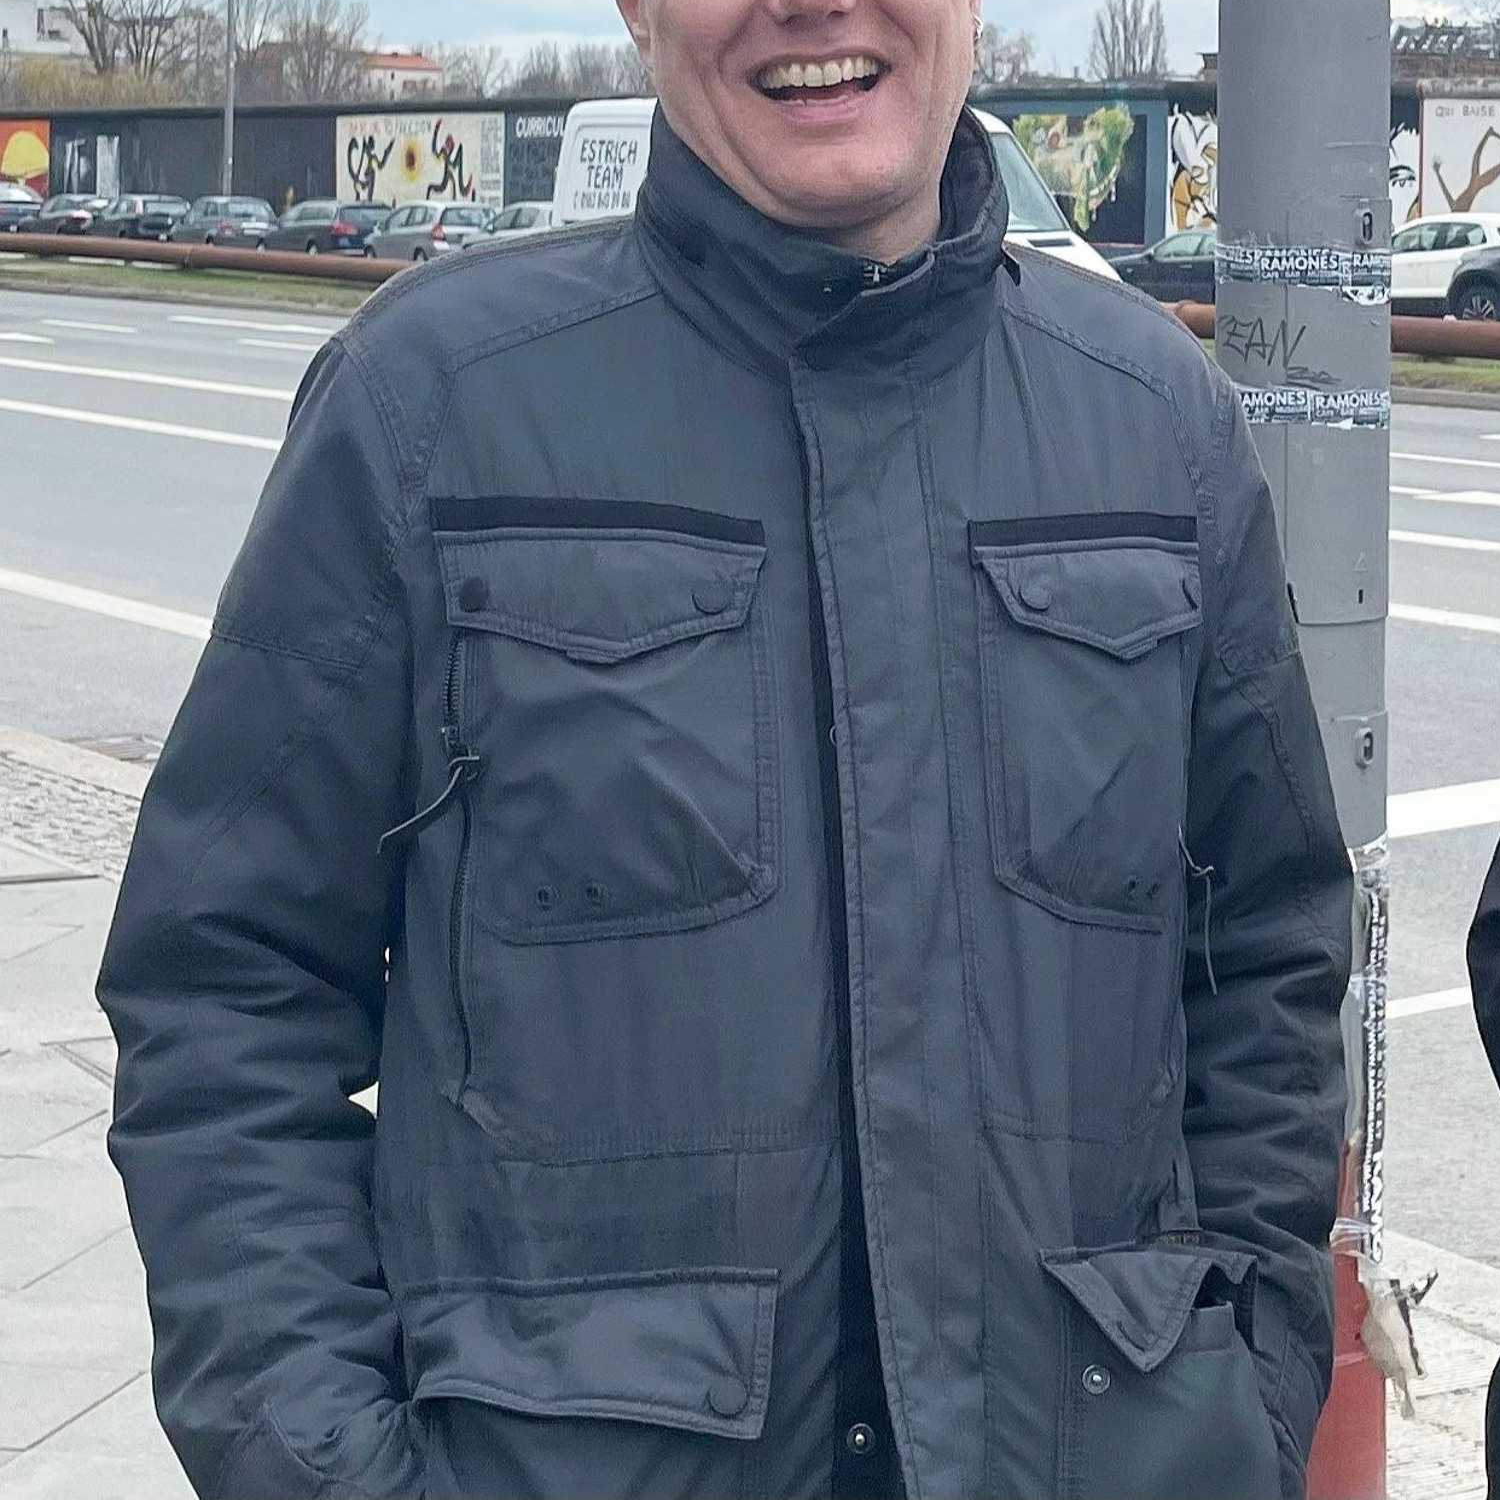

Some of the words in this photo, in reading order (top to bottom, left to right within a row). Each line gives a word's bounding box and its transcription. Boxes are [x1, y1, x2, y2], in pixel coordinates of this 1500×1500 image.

[579, 138, 638, 165] ESTRICH
[587, 165, 624, 190] TEAM
[1259, 254, 1339, 271] RAMONES
[1240, 390, 1307, 407] AMONES
